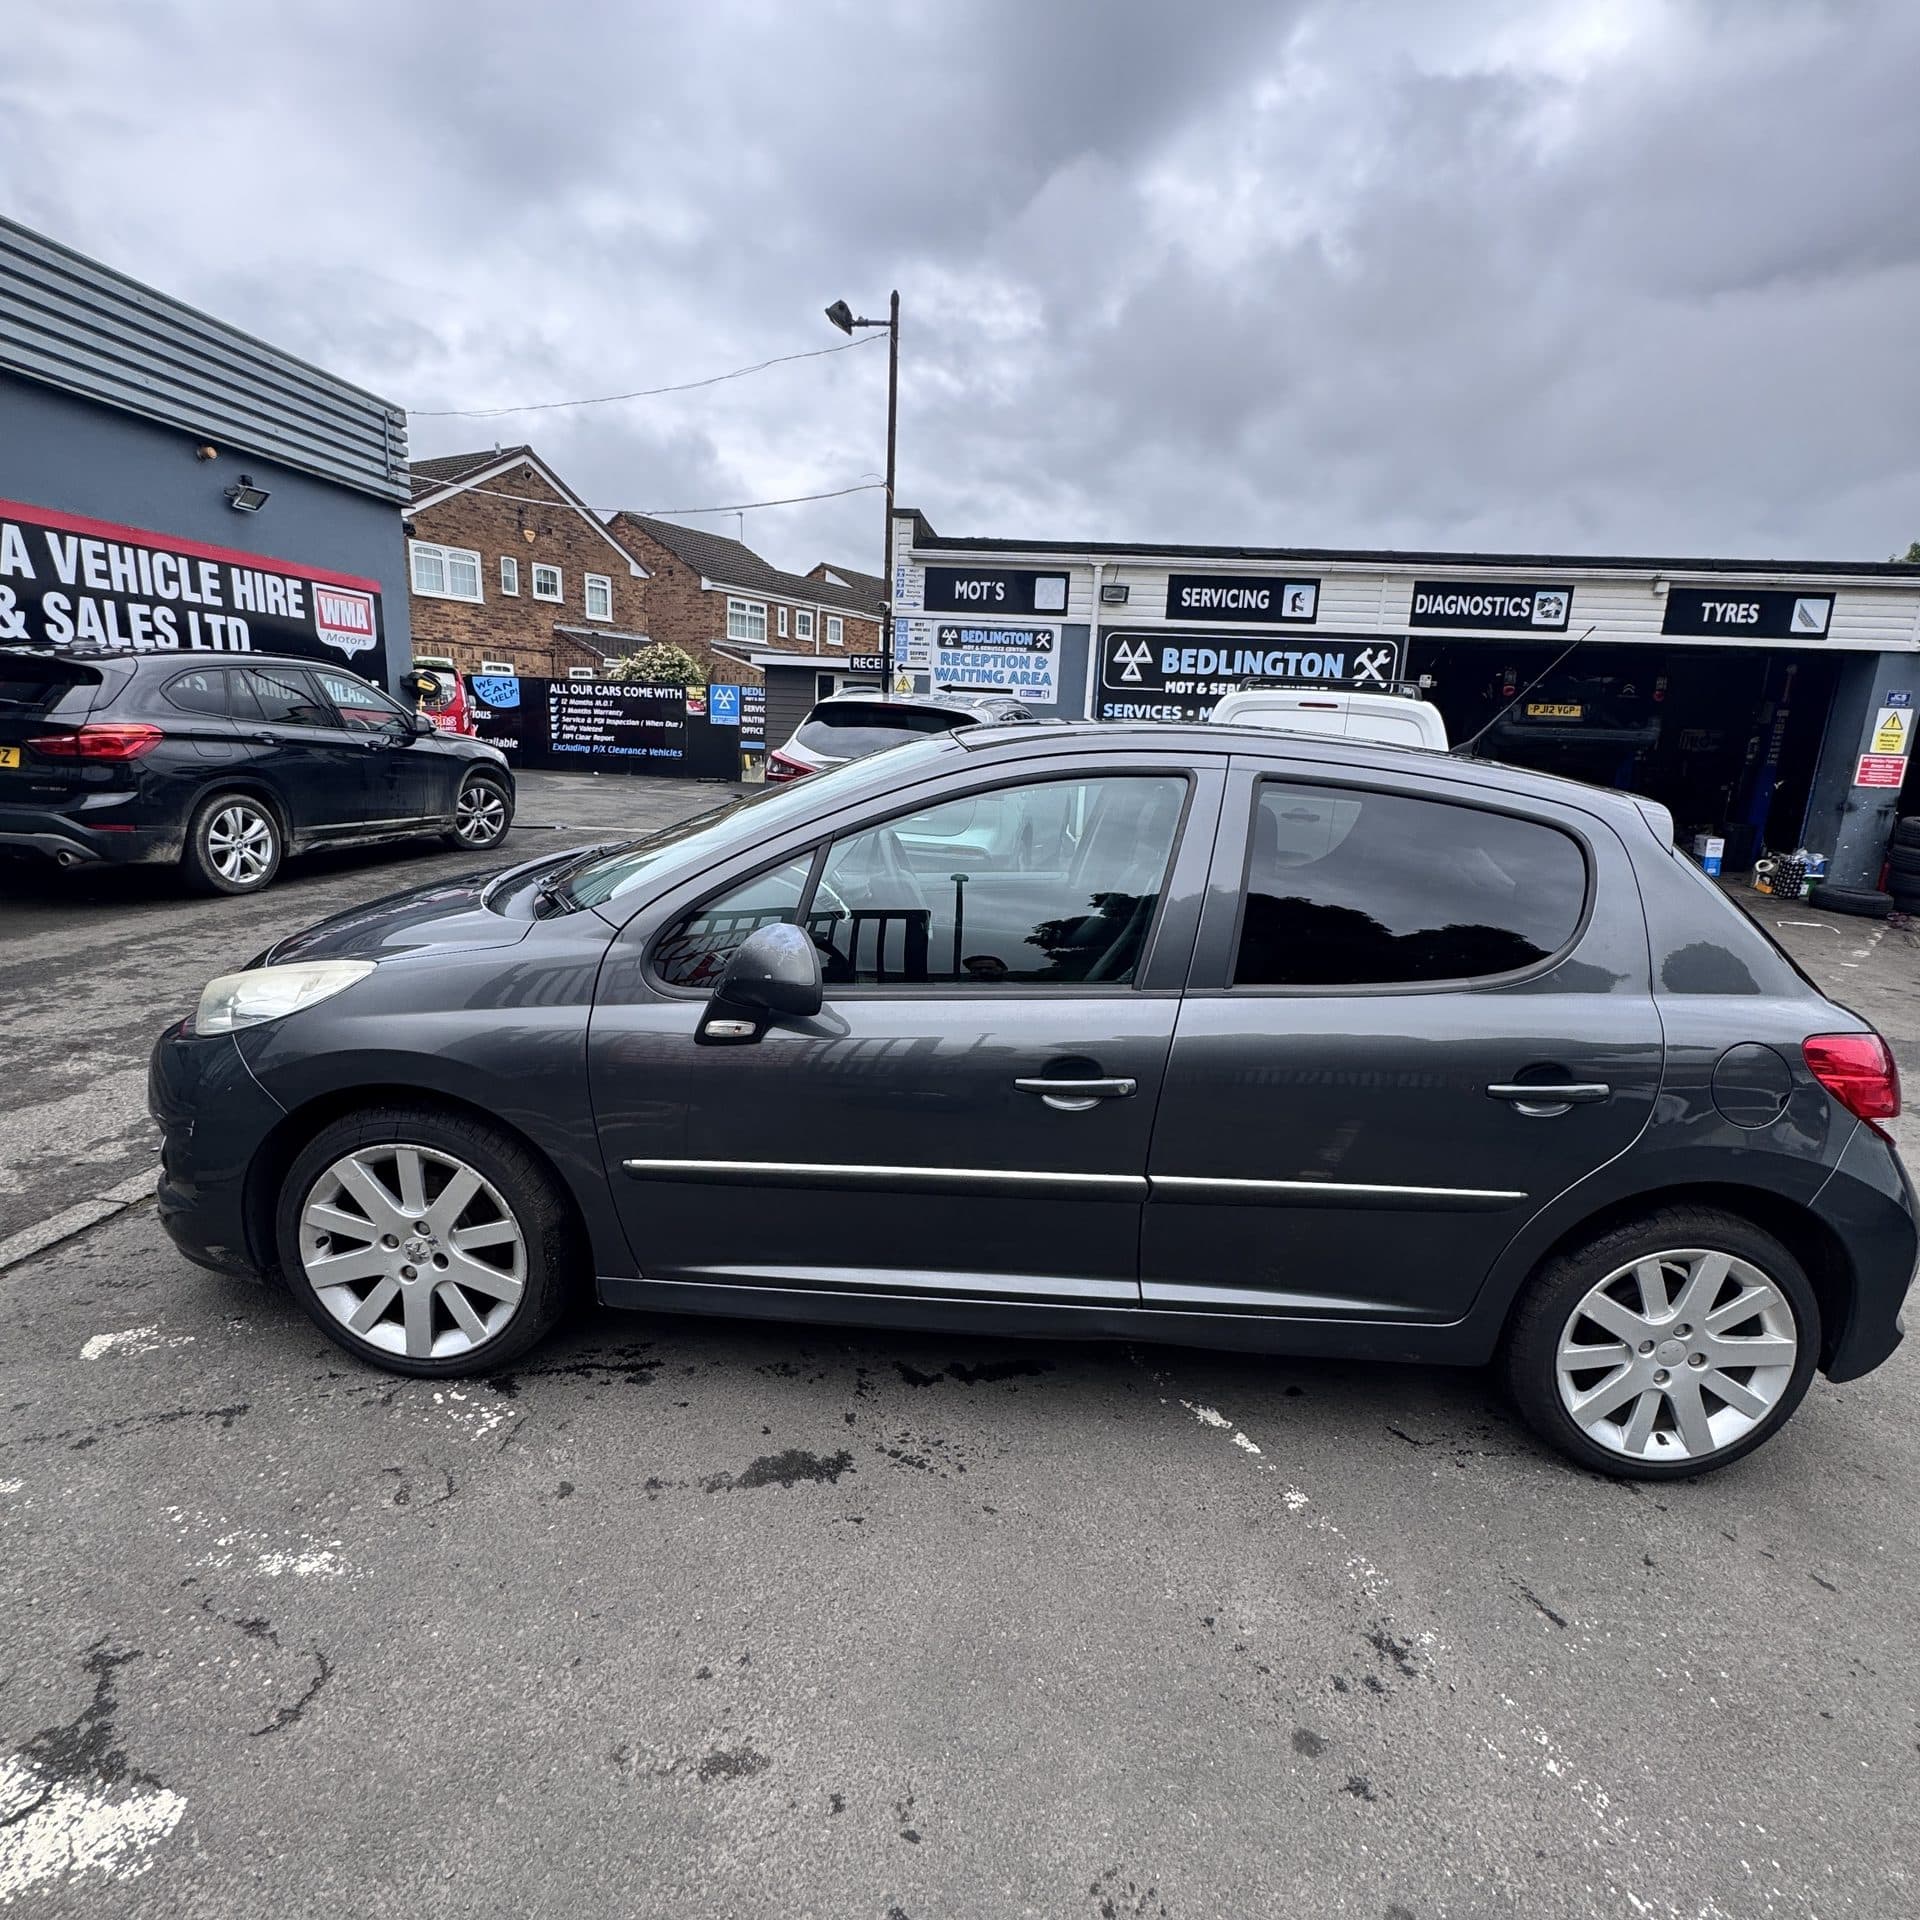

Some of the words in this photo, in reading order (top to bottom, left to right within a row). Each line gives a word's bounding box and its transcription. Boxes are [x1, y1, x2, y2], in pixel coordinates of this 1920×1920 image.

[45, 531, 222, 607] VEHICLE
[231, 568, 305, 619] HIRE
[954, 580, 1005, 601] MOT'S
[1181, 587, 1271, 610] SERVICING
[319, 596, 369, 630] WMA
[1415, 594, 1531, 617] DIAGNOSTICS
[1701, 602, 1760, 624] TYRES
[42, 591, 179, 649] SALES
[326, 633, 367, 646] Motors
[960, 629, 1033, 645] BEDLINGTON
[940, 652, 1031, 669] RECEPTION
[1034, 656, 1048, 670] &
[1161, 648, 1344, 679] BEDLINGTON
[475, 679, 493, 690] WE
[934, 667, 1005, 684] WAITING
[1008, 670, 1052, 686] AREA
[482, 680, 513, 697] CAN
[490, 688, 518, 704] HELP!
[549, 683, 568, 694] ALL
[570, 684, 593, 695] OUR
[594, 685, 621, 696] CARS
[623, 687, 653, 698] COME
[654, 688, 683, 699] WITH
[1165, 681, 1195, 694] MOT
[1196, 682, 1207, 695] &
[569, 698, 593, 706] Months
[1533, 705, 1555, 714] PJ12
[1557, 706, 1576, 715] VGP
[567, 707, 592, 715] Months
[593, 708, 623, 717] Warranty
[1103, 703, 1182, 719] SERVICES
[562, 724, 578, 732] Fully
[579, 725, 603, 733] Valeted
[606, 718, 640, 726] Inspection
[575, 733, 592, 741] Clear
[593, 734, 615, 742] Report
[741, 727, 764, 735] OFFICE
[552, 743, 590, 754] Excluding
[592, 744, 606, 754] P/X
[607, 745, 647, 756] Clearance
[649, 747, 683, 758] Vehicles
